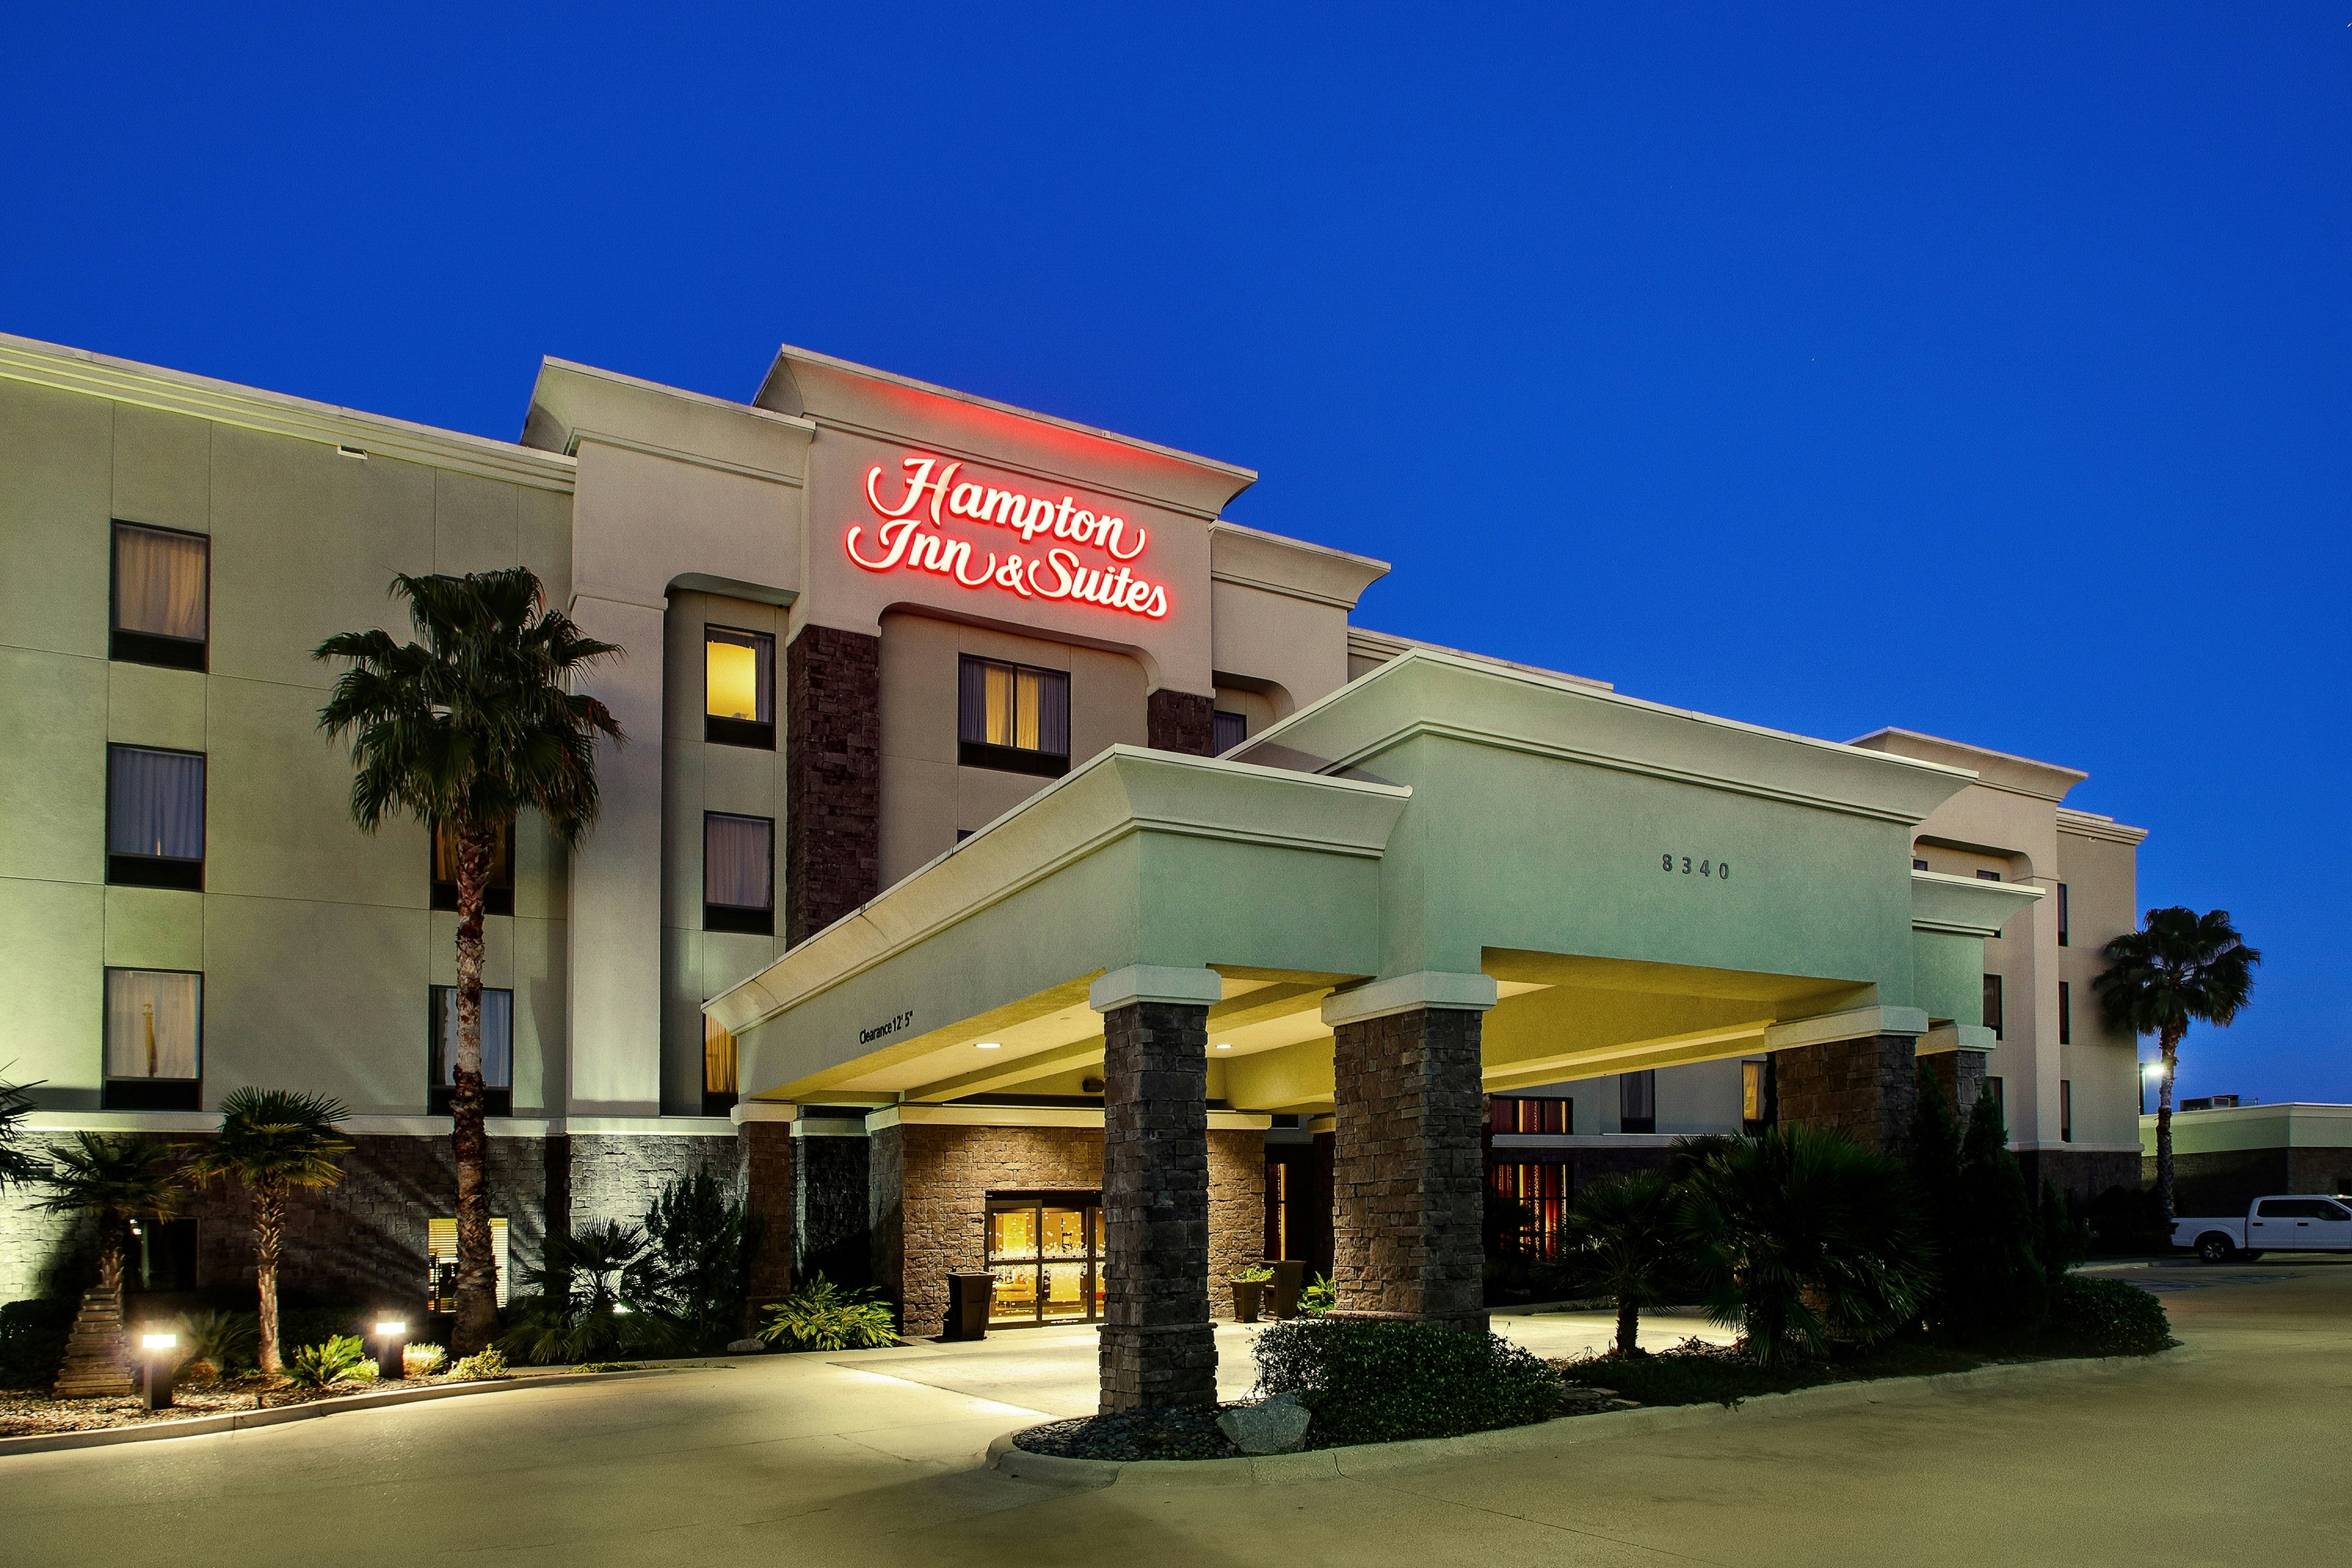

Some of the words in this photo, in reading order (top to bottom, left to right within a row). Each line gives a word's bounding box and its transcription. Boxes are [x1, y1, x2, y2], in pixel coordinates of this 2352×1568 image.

[867, 458, 1146, 560] Hampton
[846, 518, 996, 588] Inn
[994, 555, 1032, 598] &
[1028, 548, 1168, 620] Suites
[1663, 854, 1728, 880] 8340
[859, 1022, 892, 1044] Clearance
